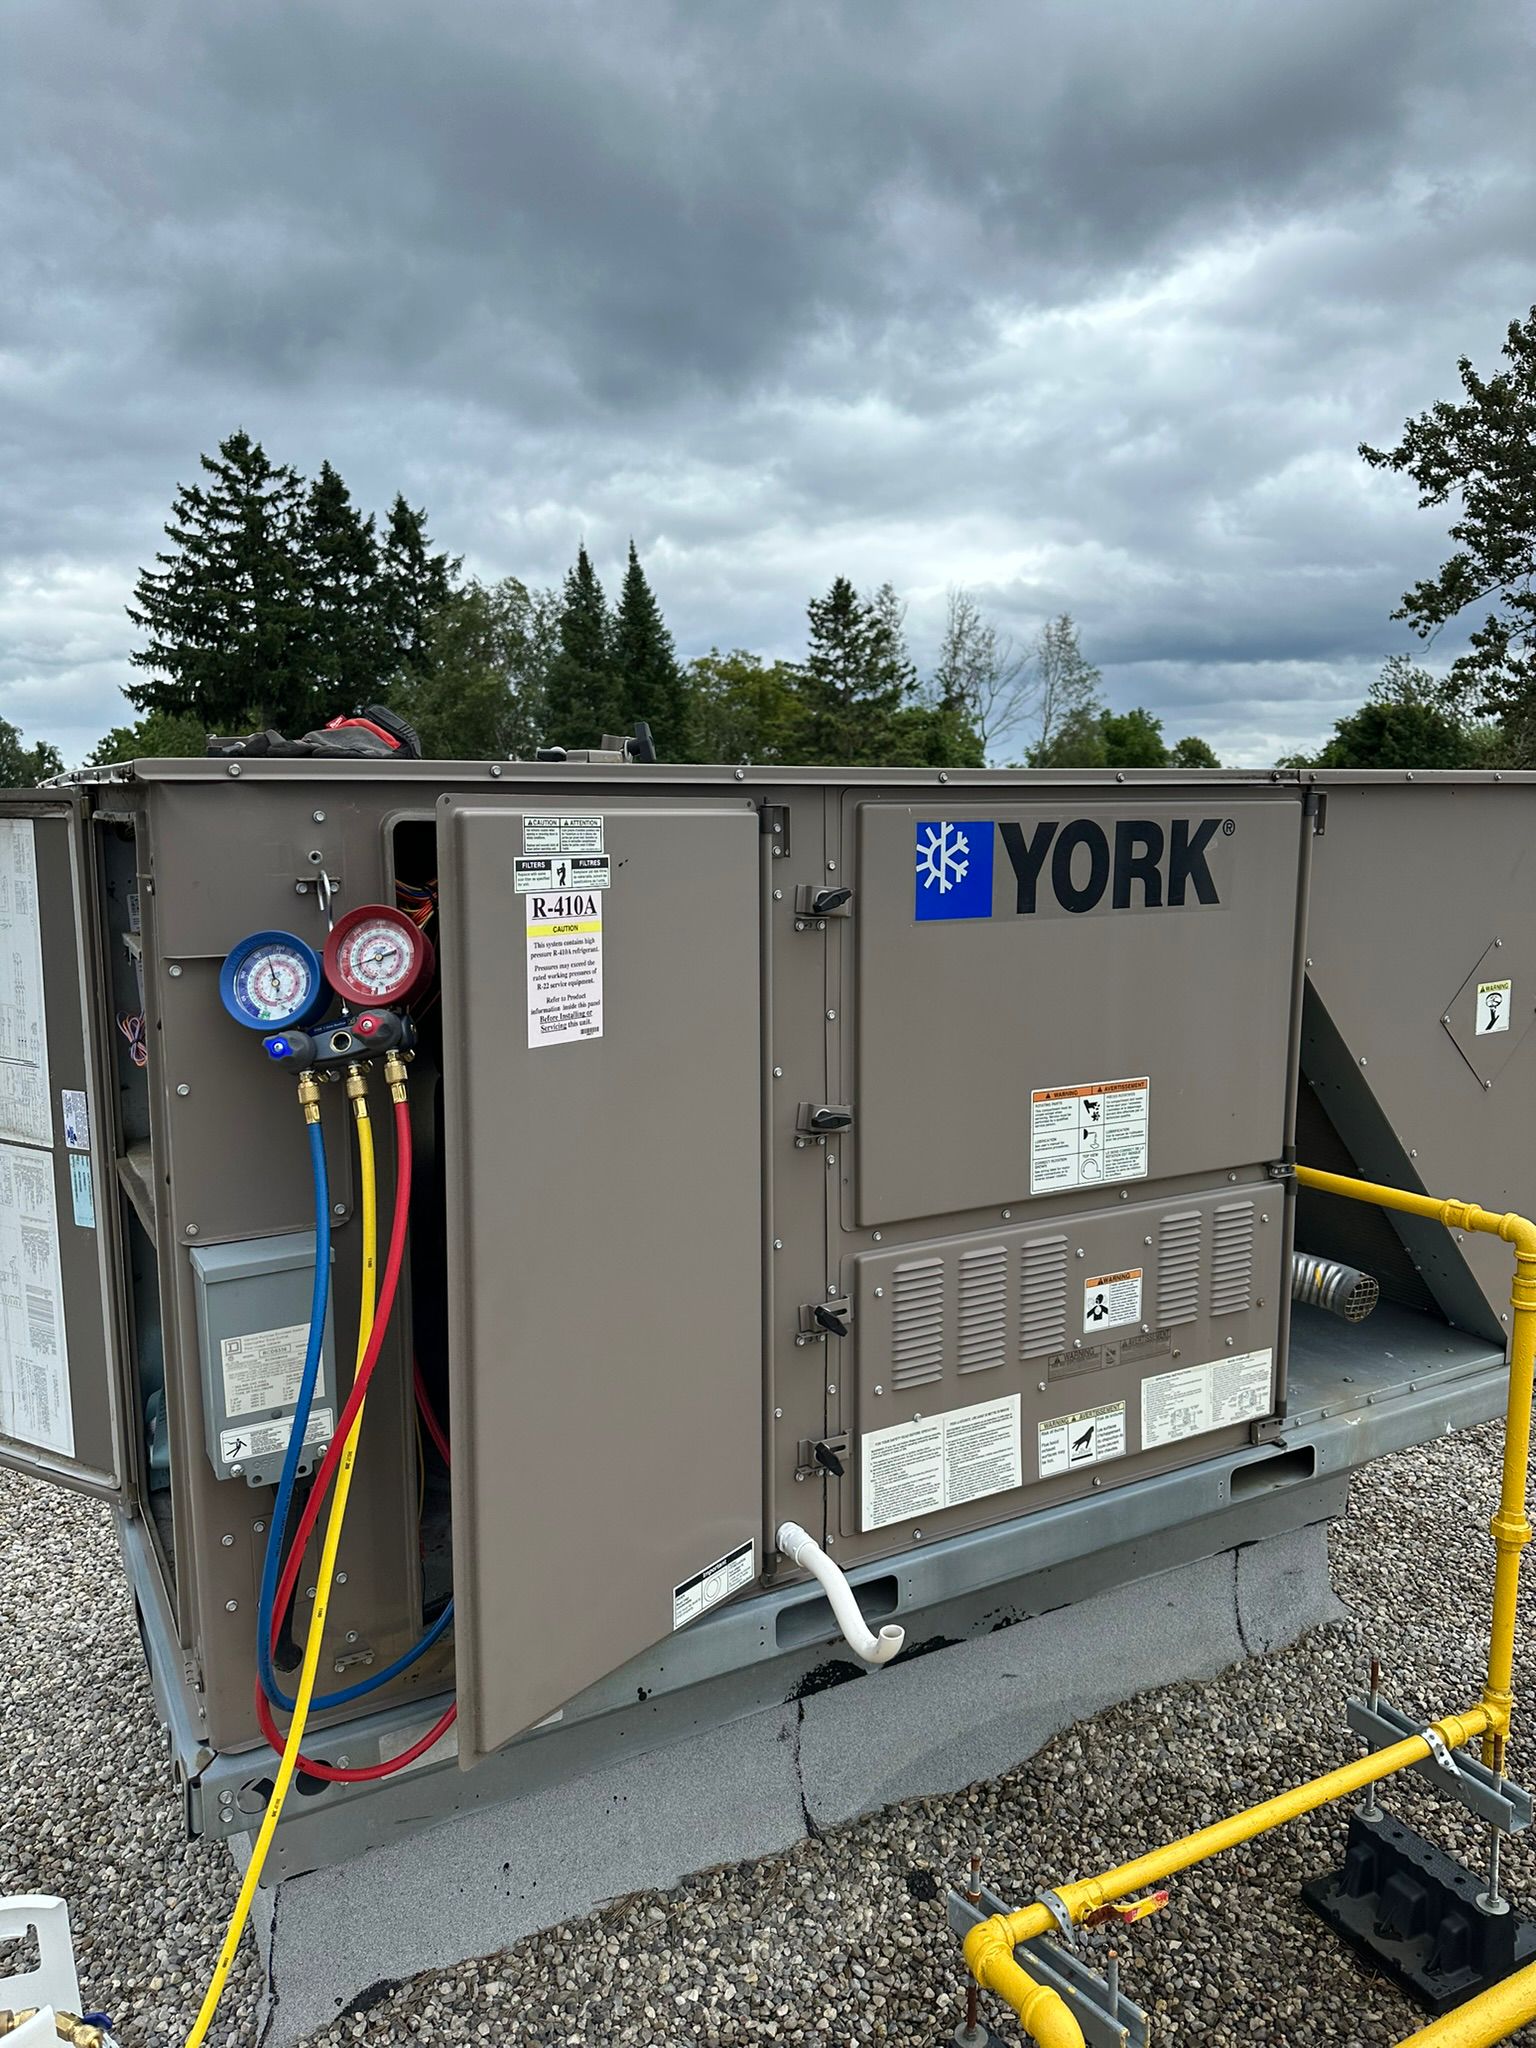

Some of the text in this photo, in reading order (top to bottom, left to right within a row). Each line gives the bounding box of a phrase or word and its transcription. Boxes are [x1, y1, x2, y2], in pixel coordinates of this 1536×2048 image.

[532, 895, 597, 918] R-410A
[1486, 983, 1509, 991] WARNING
[560, 1010, 585, 1019] Installing
[541, 1023, 567, 1031] Servicing
[1104, 1082, 1145, 1092] AVERTISSEMENT
[1102, 1272, 1130, 1284] WARNING
[1064, 1346, 1095, 1360] WARNING
[1044, 1417, 1069, 1428] WARNING
